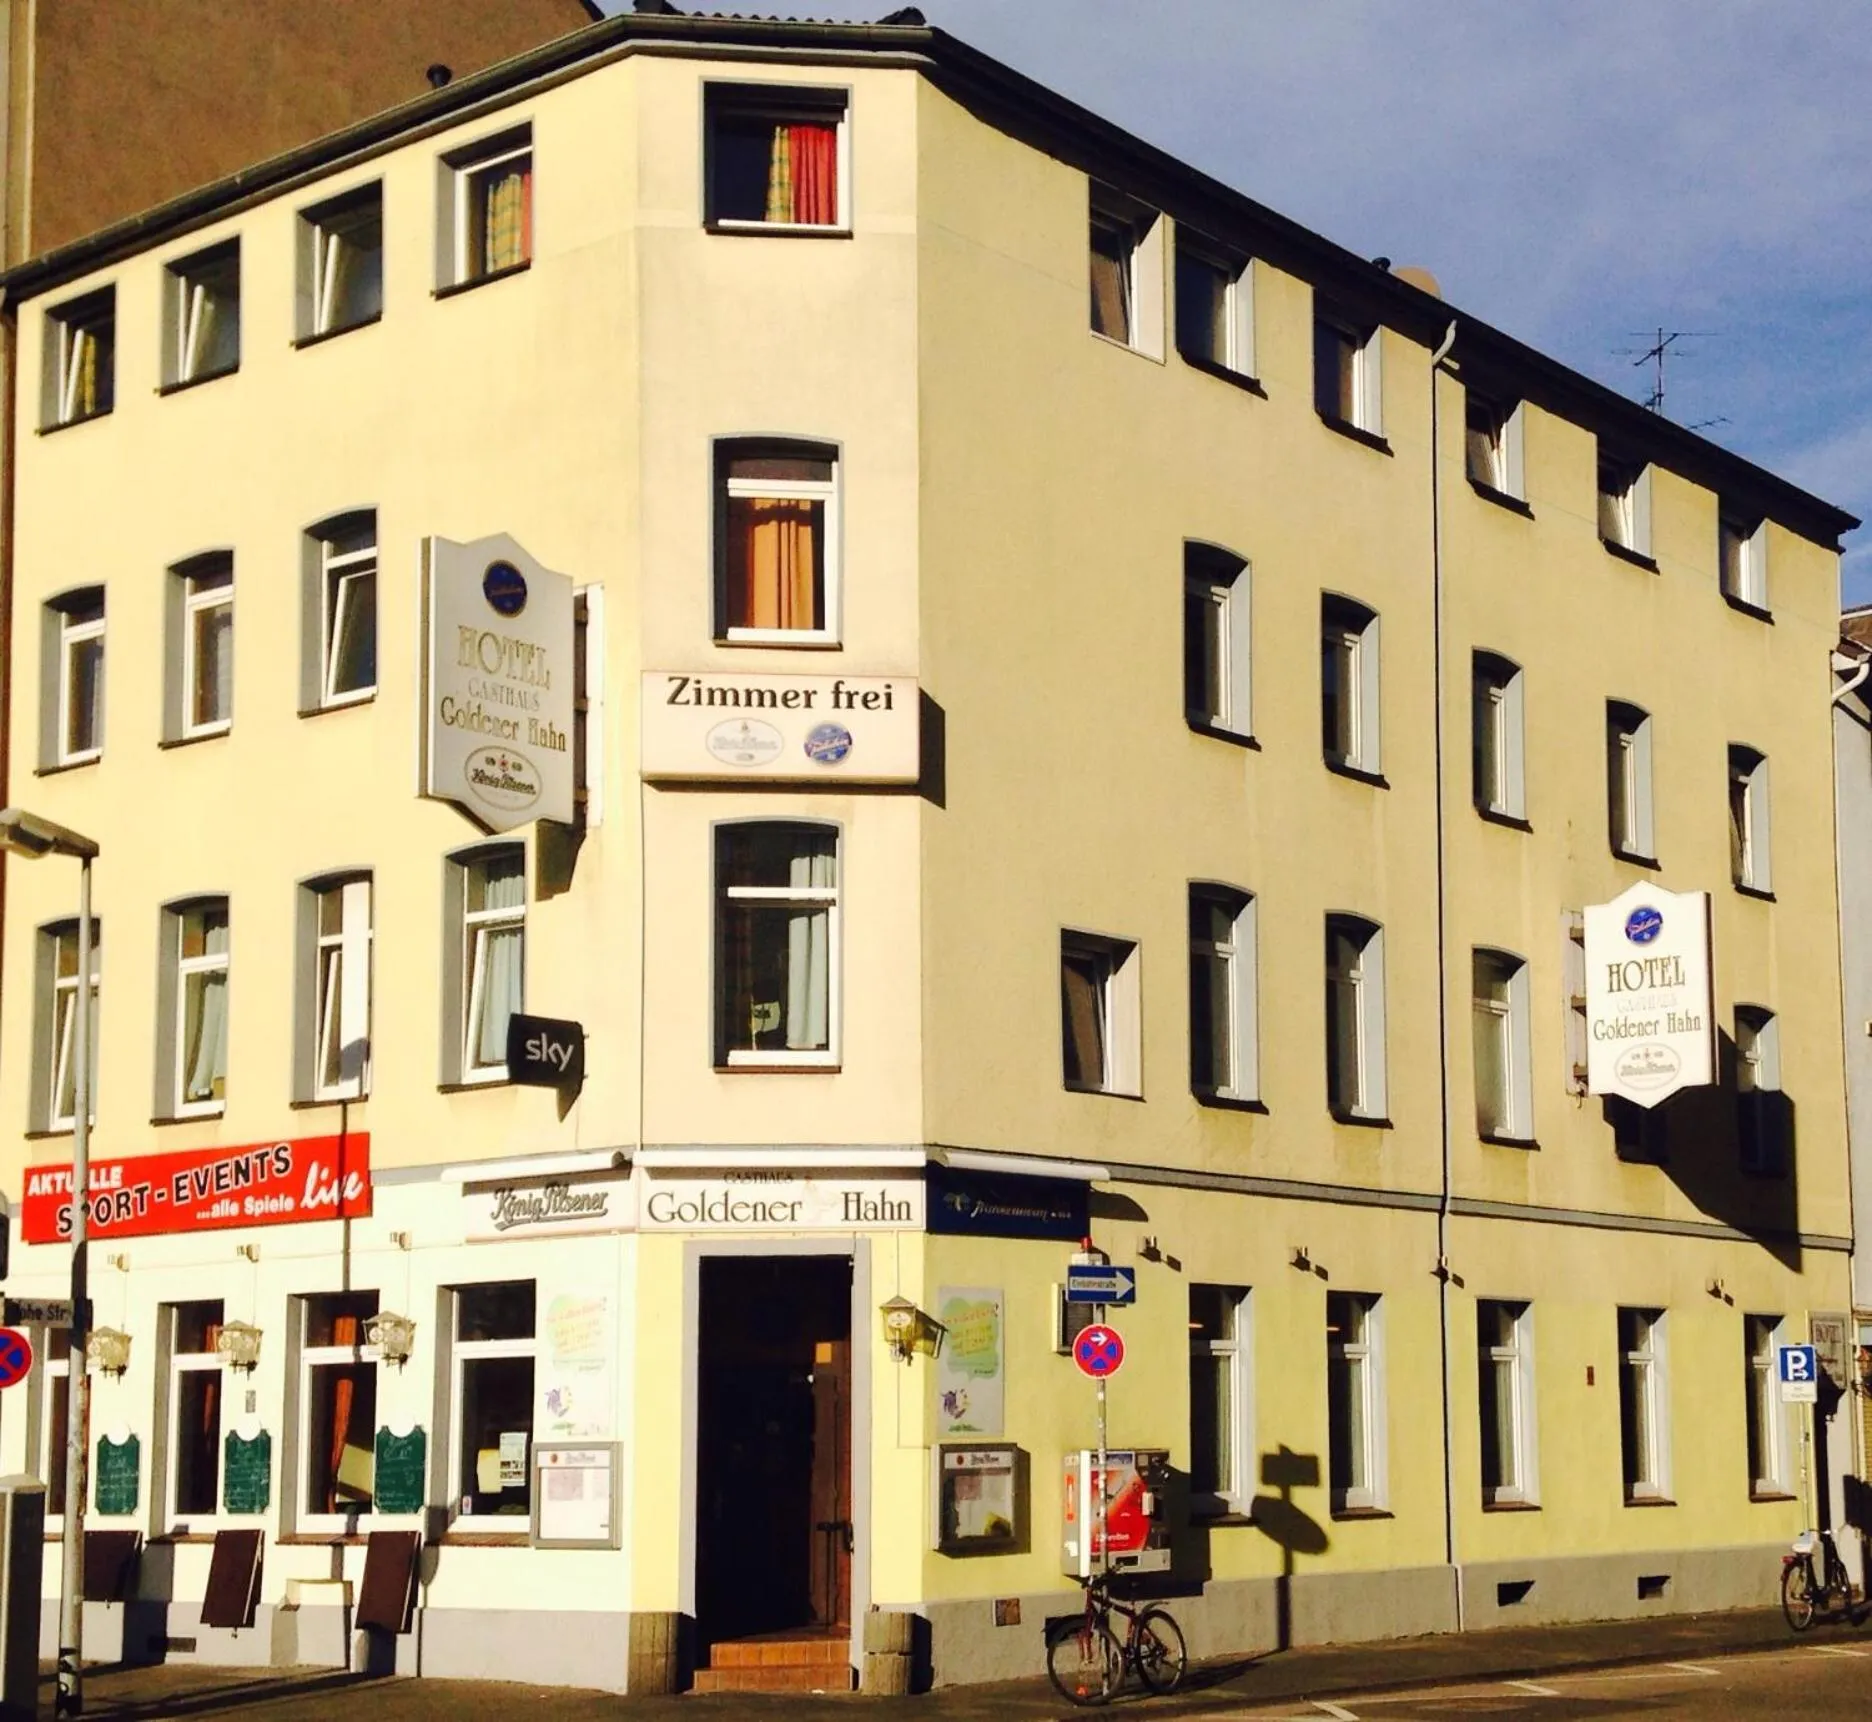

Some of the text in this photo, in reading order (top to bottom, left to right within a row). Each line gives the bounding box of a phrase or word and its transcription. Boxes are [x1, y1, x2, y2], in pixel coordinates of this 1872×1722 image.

[457, 624, 550, 690] HOTEL
[467, 677, 541, 712] GASTHAUS
[666, 676, 894, 711] Zimmer frei
[440, 695, 567, 753] Goldener Hahn
[1606, 955, 1686, 993] HOTEL
[1593, 1008, 1702, 1042] Goldener Hahn
[525, 1032, 575, 1072] sky
[28, 1165, 123, 1196] AKTULLE
[57, 1183, 151, 1237] SORT
[173, 1142, 293, 1206] EVENTS
[301, 1161, 365, 1210] live
[723, 1171, 795, 1185] GASTHAUS
[244, 1192, 295, 1218] Spiele
[490, 1181, 610, 1223] König Pilsener
[647, 1188, 913, 1223] Goldener Hahn
[17, 1303, 43, 1320] ohe
